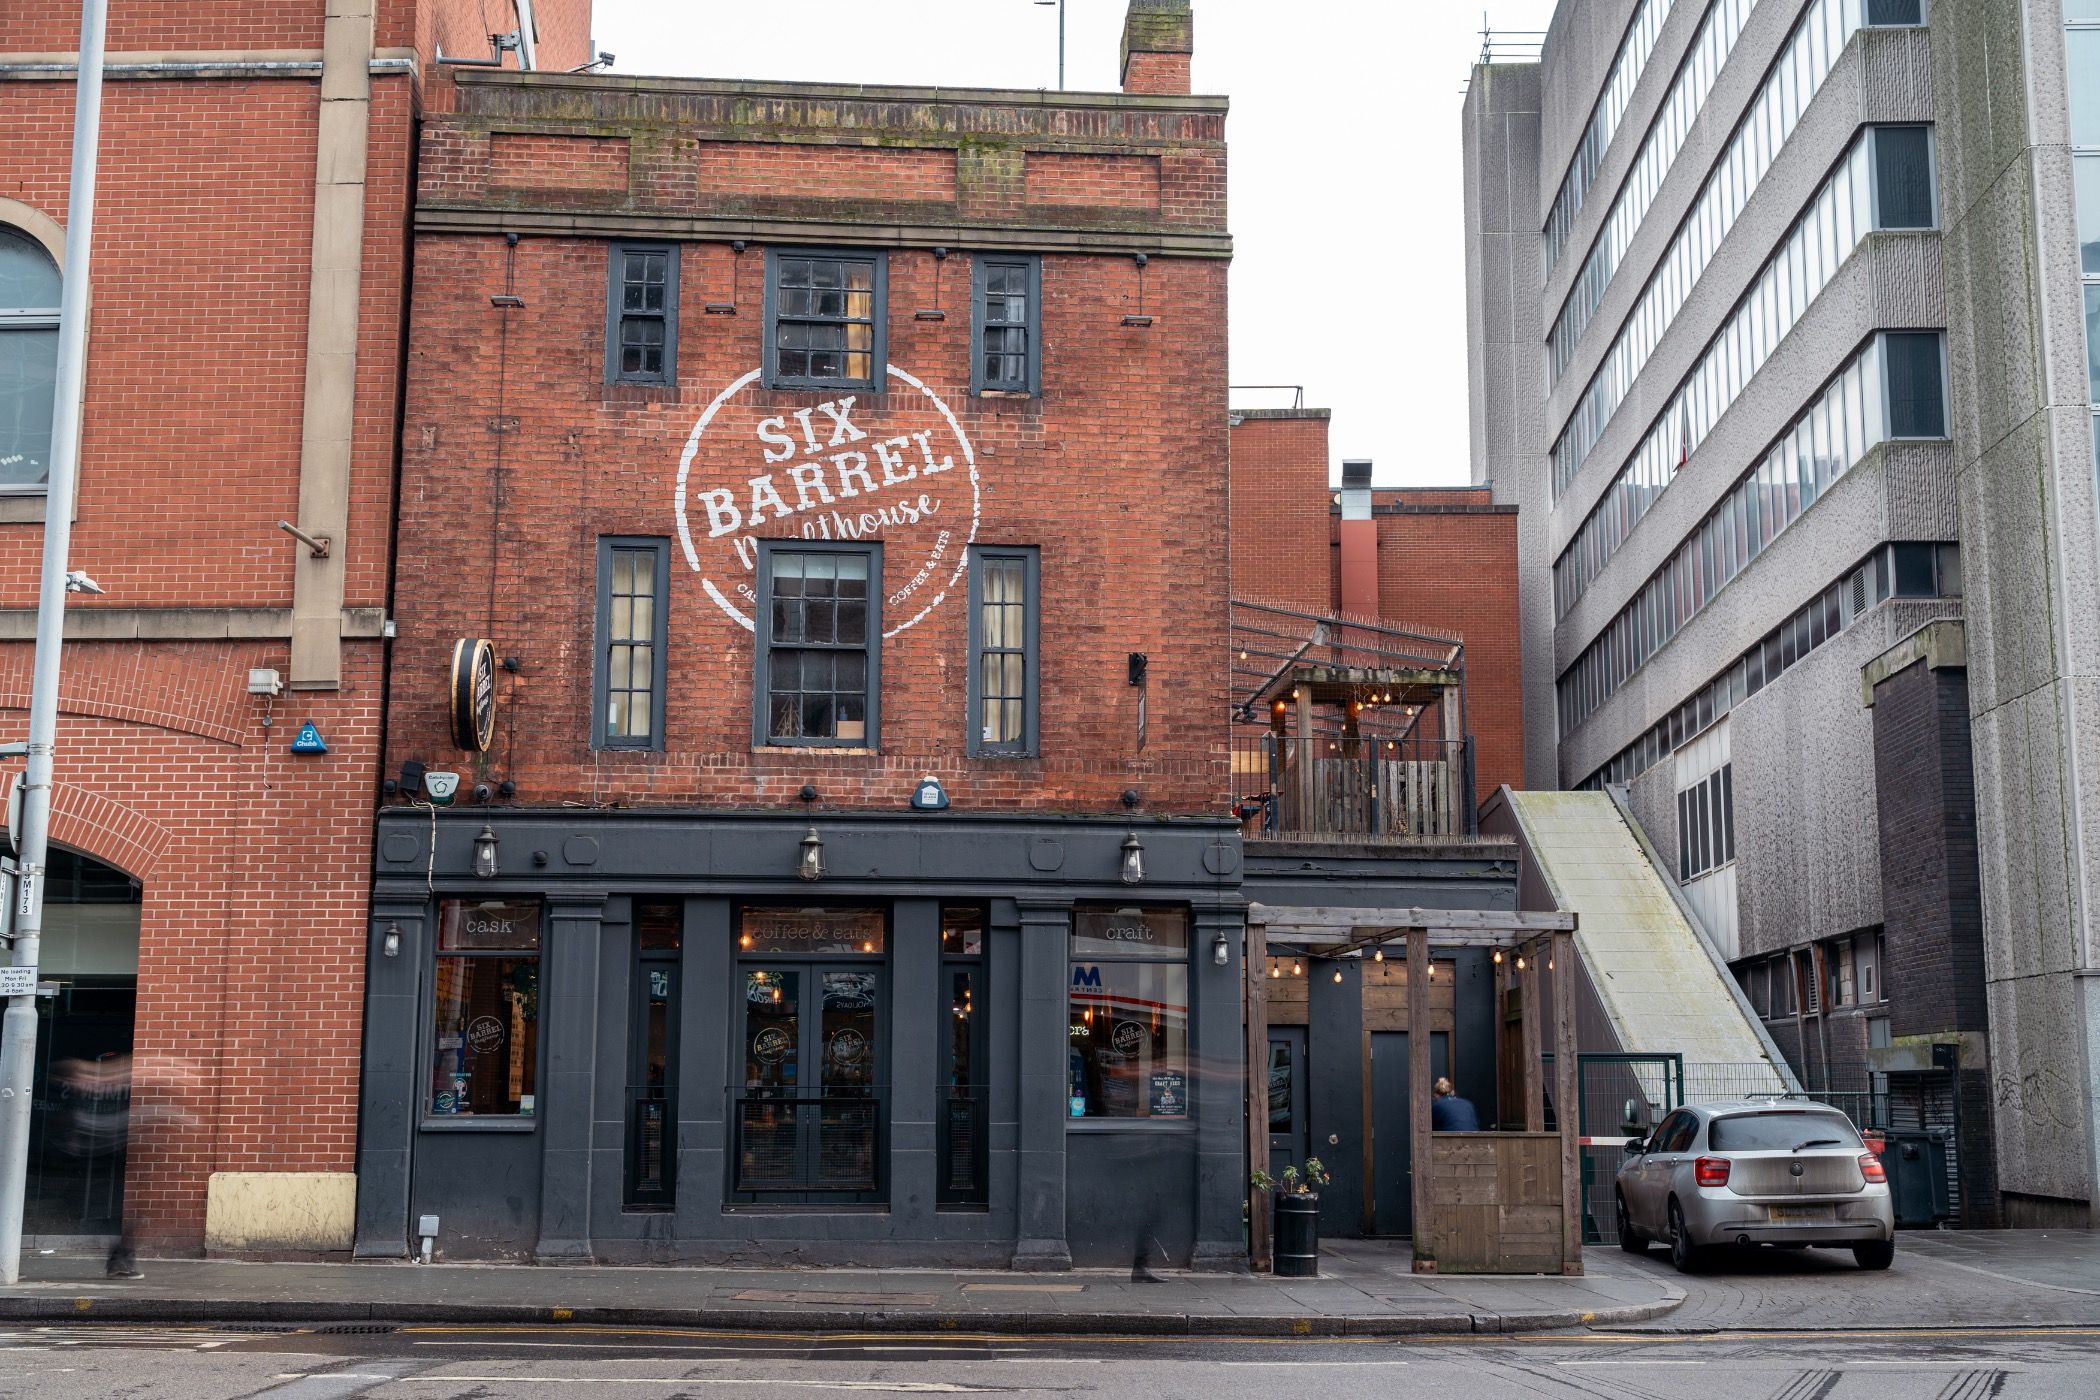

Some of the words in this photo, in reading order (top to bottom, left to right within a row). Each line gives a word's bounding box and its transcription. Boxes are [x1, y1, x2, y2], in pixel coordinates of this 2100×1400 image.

[757, 396, 867, 463] SIX
[698, 430, 954, 537] BARREL
[889, 569, 930, 605] COFFEE
[925, 560, 937, 569] &
[931, 530, 949, 560] EATS
[466, 919, 512, 933] cask
[752, 924, 809, 939] coffee
[812, 922, 828, 939] &
[833, 927, 872, 940] eats
[1106, 924, 1153, 940] craft
[470, 1025, 502, 1040] BARREL
[477, 1021, 491, 1030] SIX
[1121, 1026, 1135, 1036] SIX
[839, 1033, 852, 1042] SIX
[1115, 1030, 1145, 1044] BARREL
